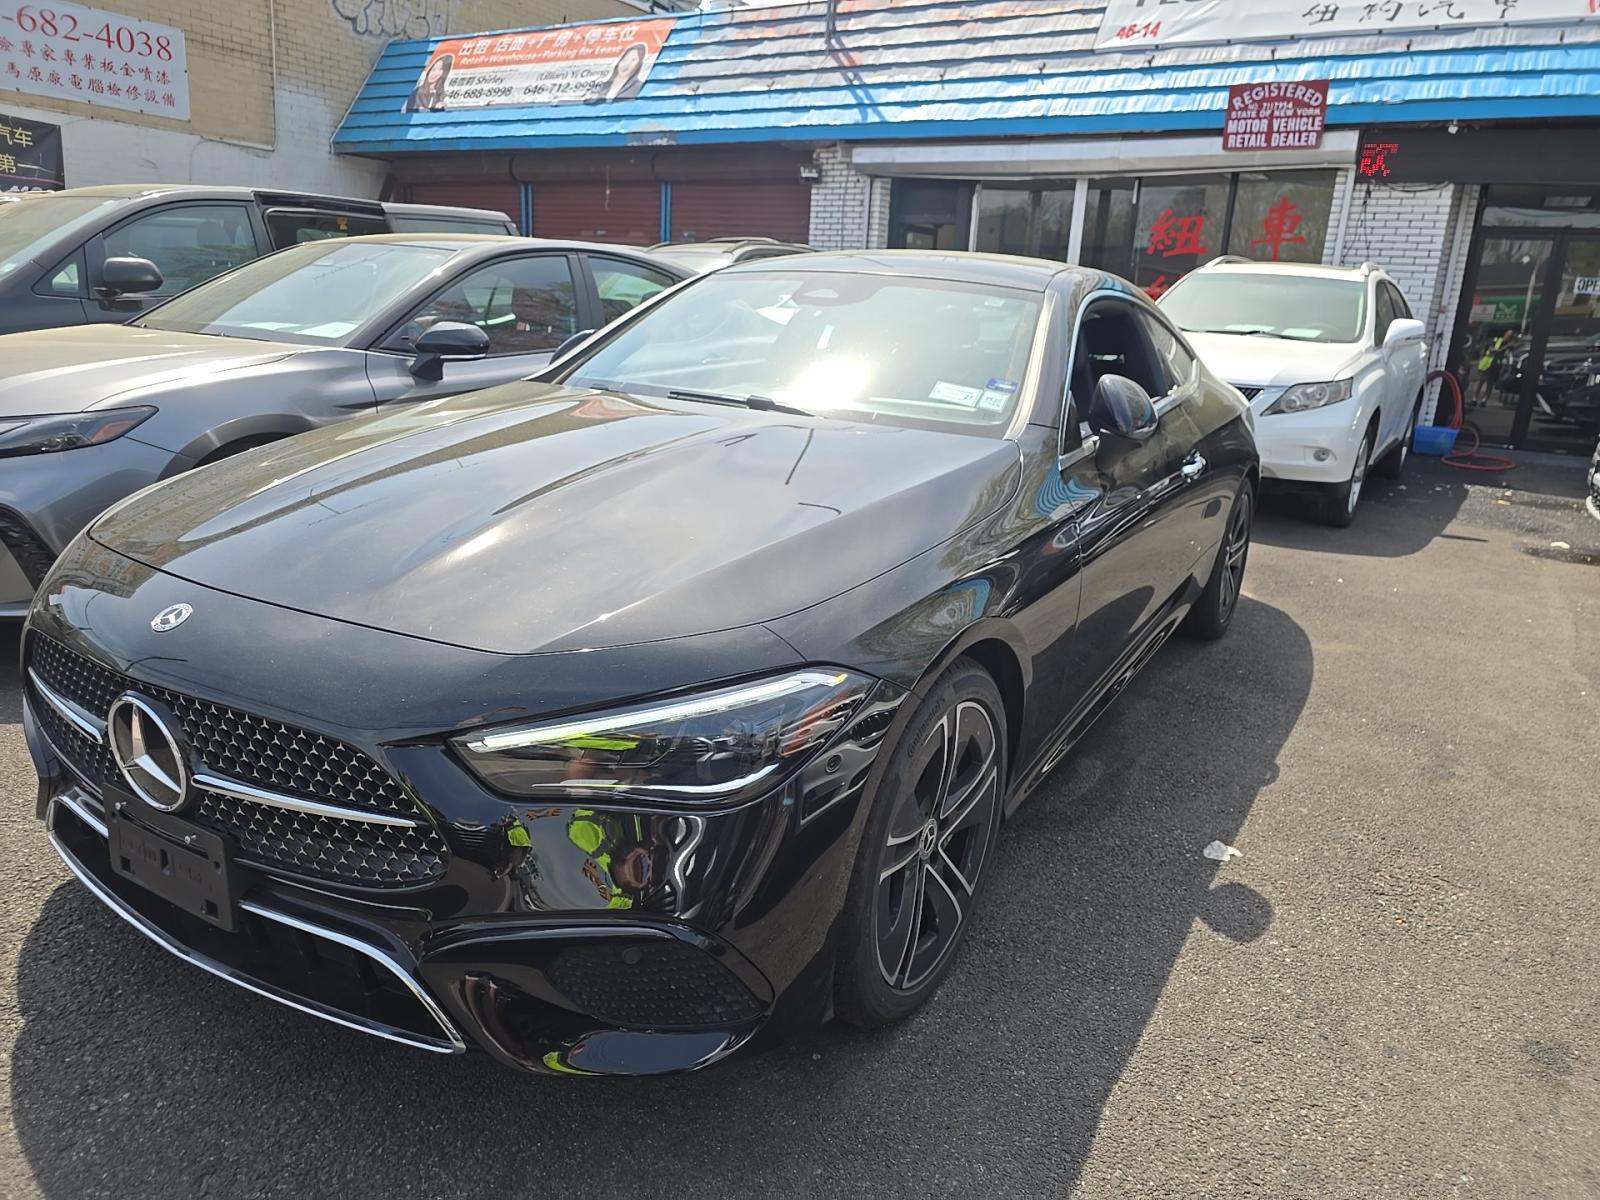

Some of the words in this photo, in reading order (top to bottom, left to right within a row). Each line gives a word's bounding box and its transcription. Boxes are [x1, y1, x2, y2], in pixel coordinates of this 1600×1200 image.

[2, 5, 172, 61] -682-4038
[447, 86, 513, 99] 46-688-8998
[1232, 83, 1323, 110] REGISTERED
[1230, 109, 1258, 119] STATE
[1259, 109, 1272, 118] OF
[1273, 108, 1295, 117] NEW
[1296, 107, 1321, 116] YORK
[1227, 119, 1268, 133] MOTOR
[1272, 116, 1323, 132] VEHICLE
[1228, 132, 1267, 148] RETAIL
[1271, 131, 1317, 147] DEALER
